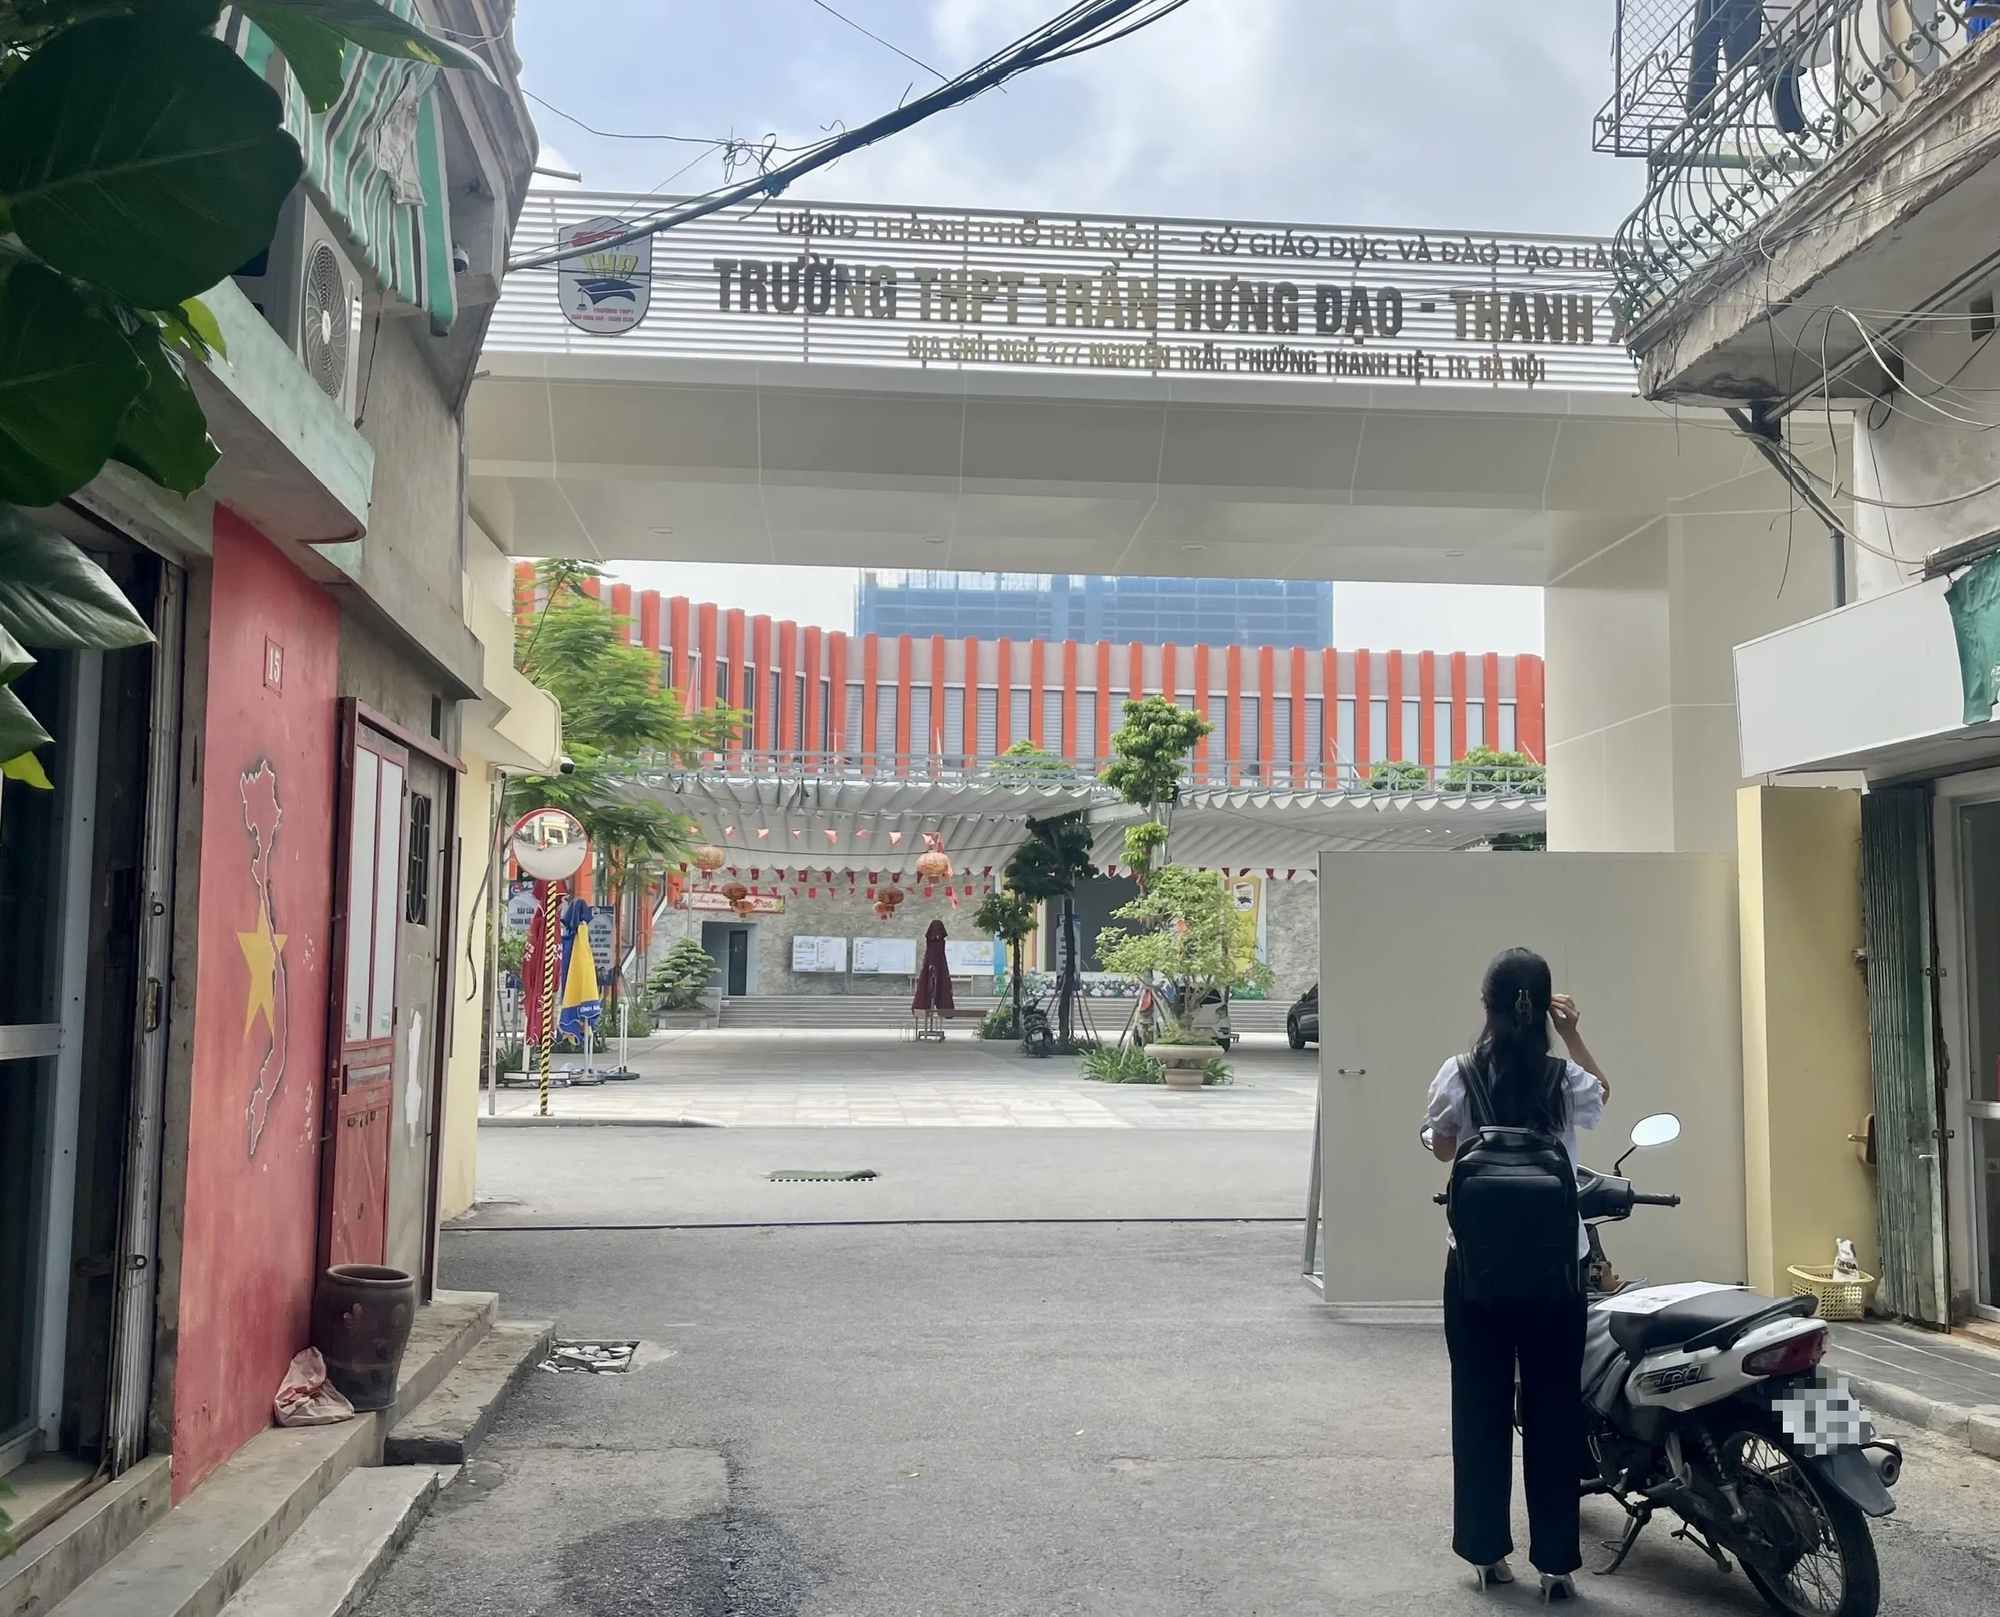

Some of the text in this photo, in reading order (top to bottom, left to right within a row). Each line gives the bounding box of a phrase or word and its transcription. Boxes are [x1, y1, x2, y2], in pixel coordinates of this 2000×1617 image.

[775, 211, 859, 238] UBND
[868, 211, 969, 243] THÀNH
[978, 216, 1041, 247] PHỐ
[1050, 220, 1090, 249] HÀ
[1099, 222, 1150, 258] NỘI
[1200, 226, 1242, 255] SỞ
[1249, 229, 1320, 259] GIÁO
[1329, 235, 1389, 268] DỤC
[1397, 234, 1433, 262] VÀ
[1440, 236, 1500, 266] ĐÀO
[1508, 243, 1563, 274] TẠO
[713, 252, 897, 319] TRƯỜNG
[913, 267, 1025, 325] THPT
[1039, 259, 1159, 330] TRẦN
[1174, 274, 1300, 334] HƯNG
[1313, 283, 1403, 345] ĐẠO
[1449, 290, 1594, 345] THANH
[1046, 340, 1083, 366] 477
[1234, 343, 1318, 374] PHƯỜNG
[1323, 350, 1389, 376] THANH
[1478, 350, 1505, 381] HÀ
[1510, 352, 1545, 384] NỘI
[269, 647, 280, 684] 15
